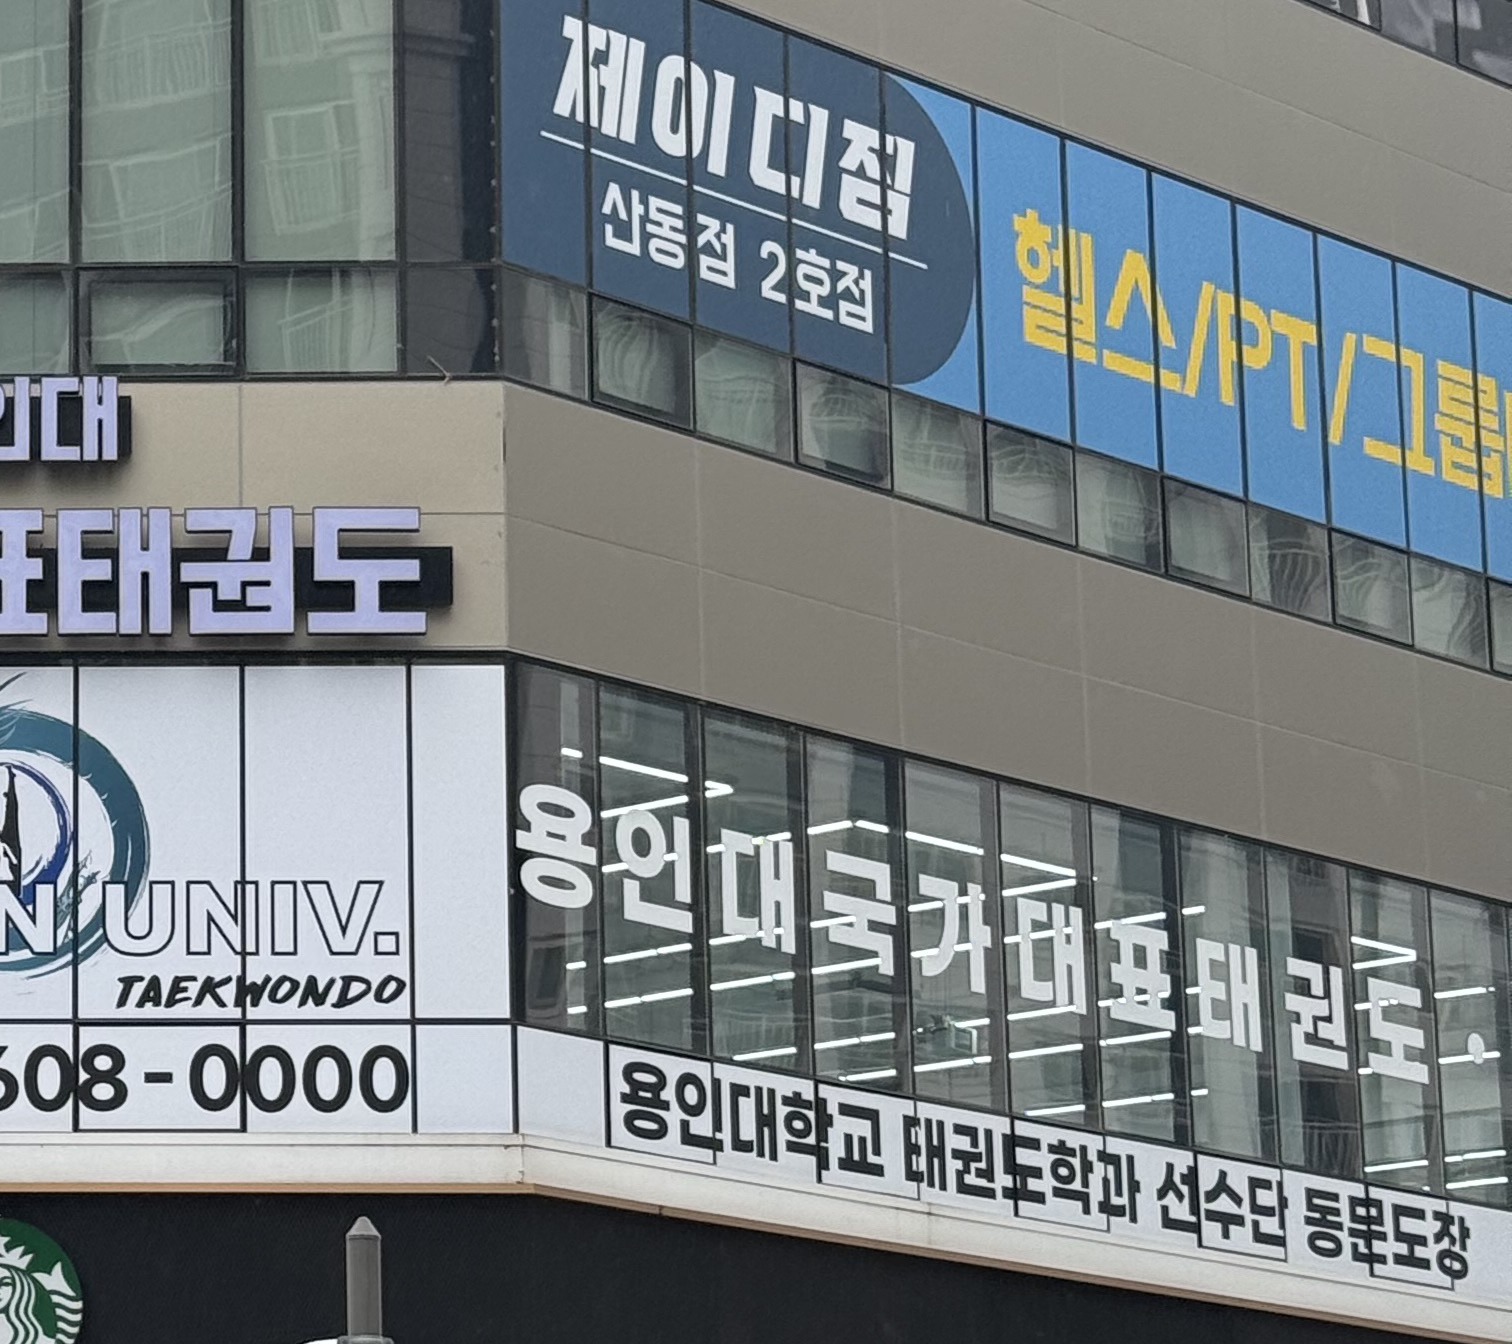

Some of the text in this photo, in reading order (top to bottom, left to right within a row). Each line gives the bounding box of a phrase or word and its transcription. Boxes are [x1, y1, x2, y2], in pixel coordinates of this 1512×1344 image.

[551, 13, 917, 241] 제이디짐
[601, 180, 874, 334] 산동점 2호점
[101, 879, 402, 958] UNIV.
[114, 974, 406, 1010] TAEKWONDO
[619, 1060, 1471, 1282] 용인대학교 태권도학과 선수단 동문도장
